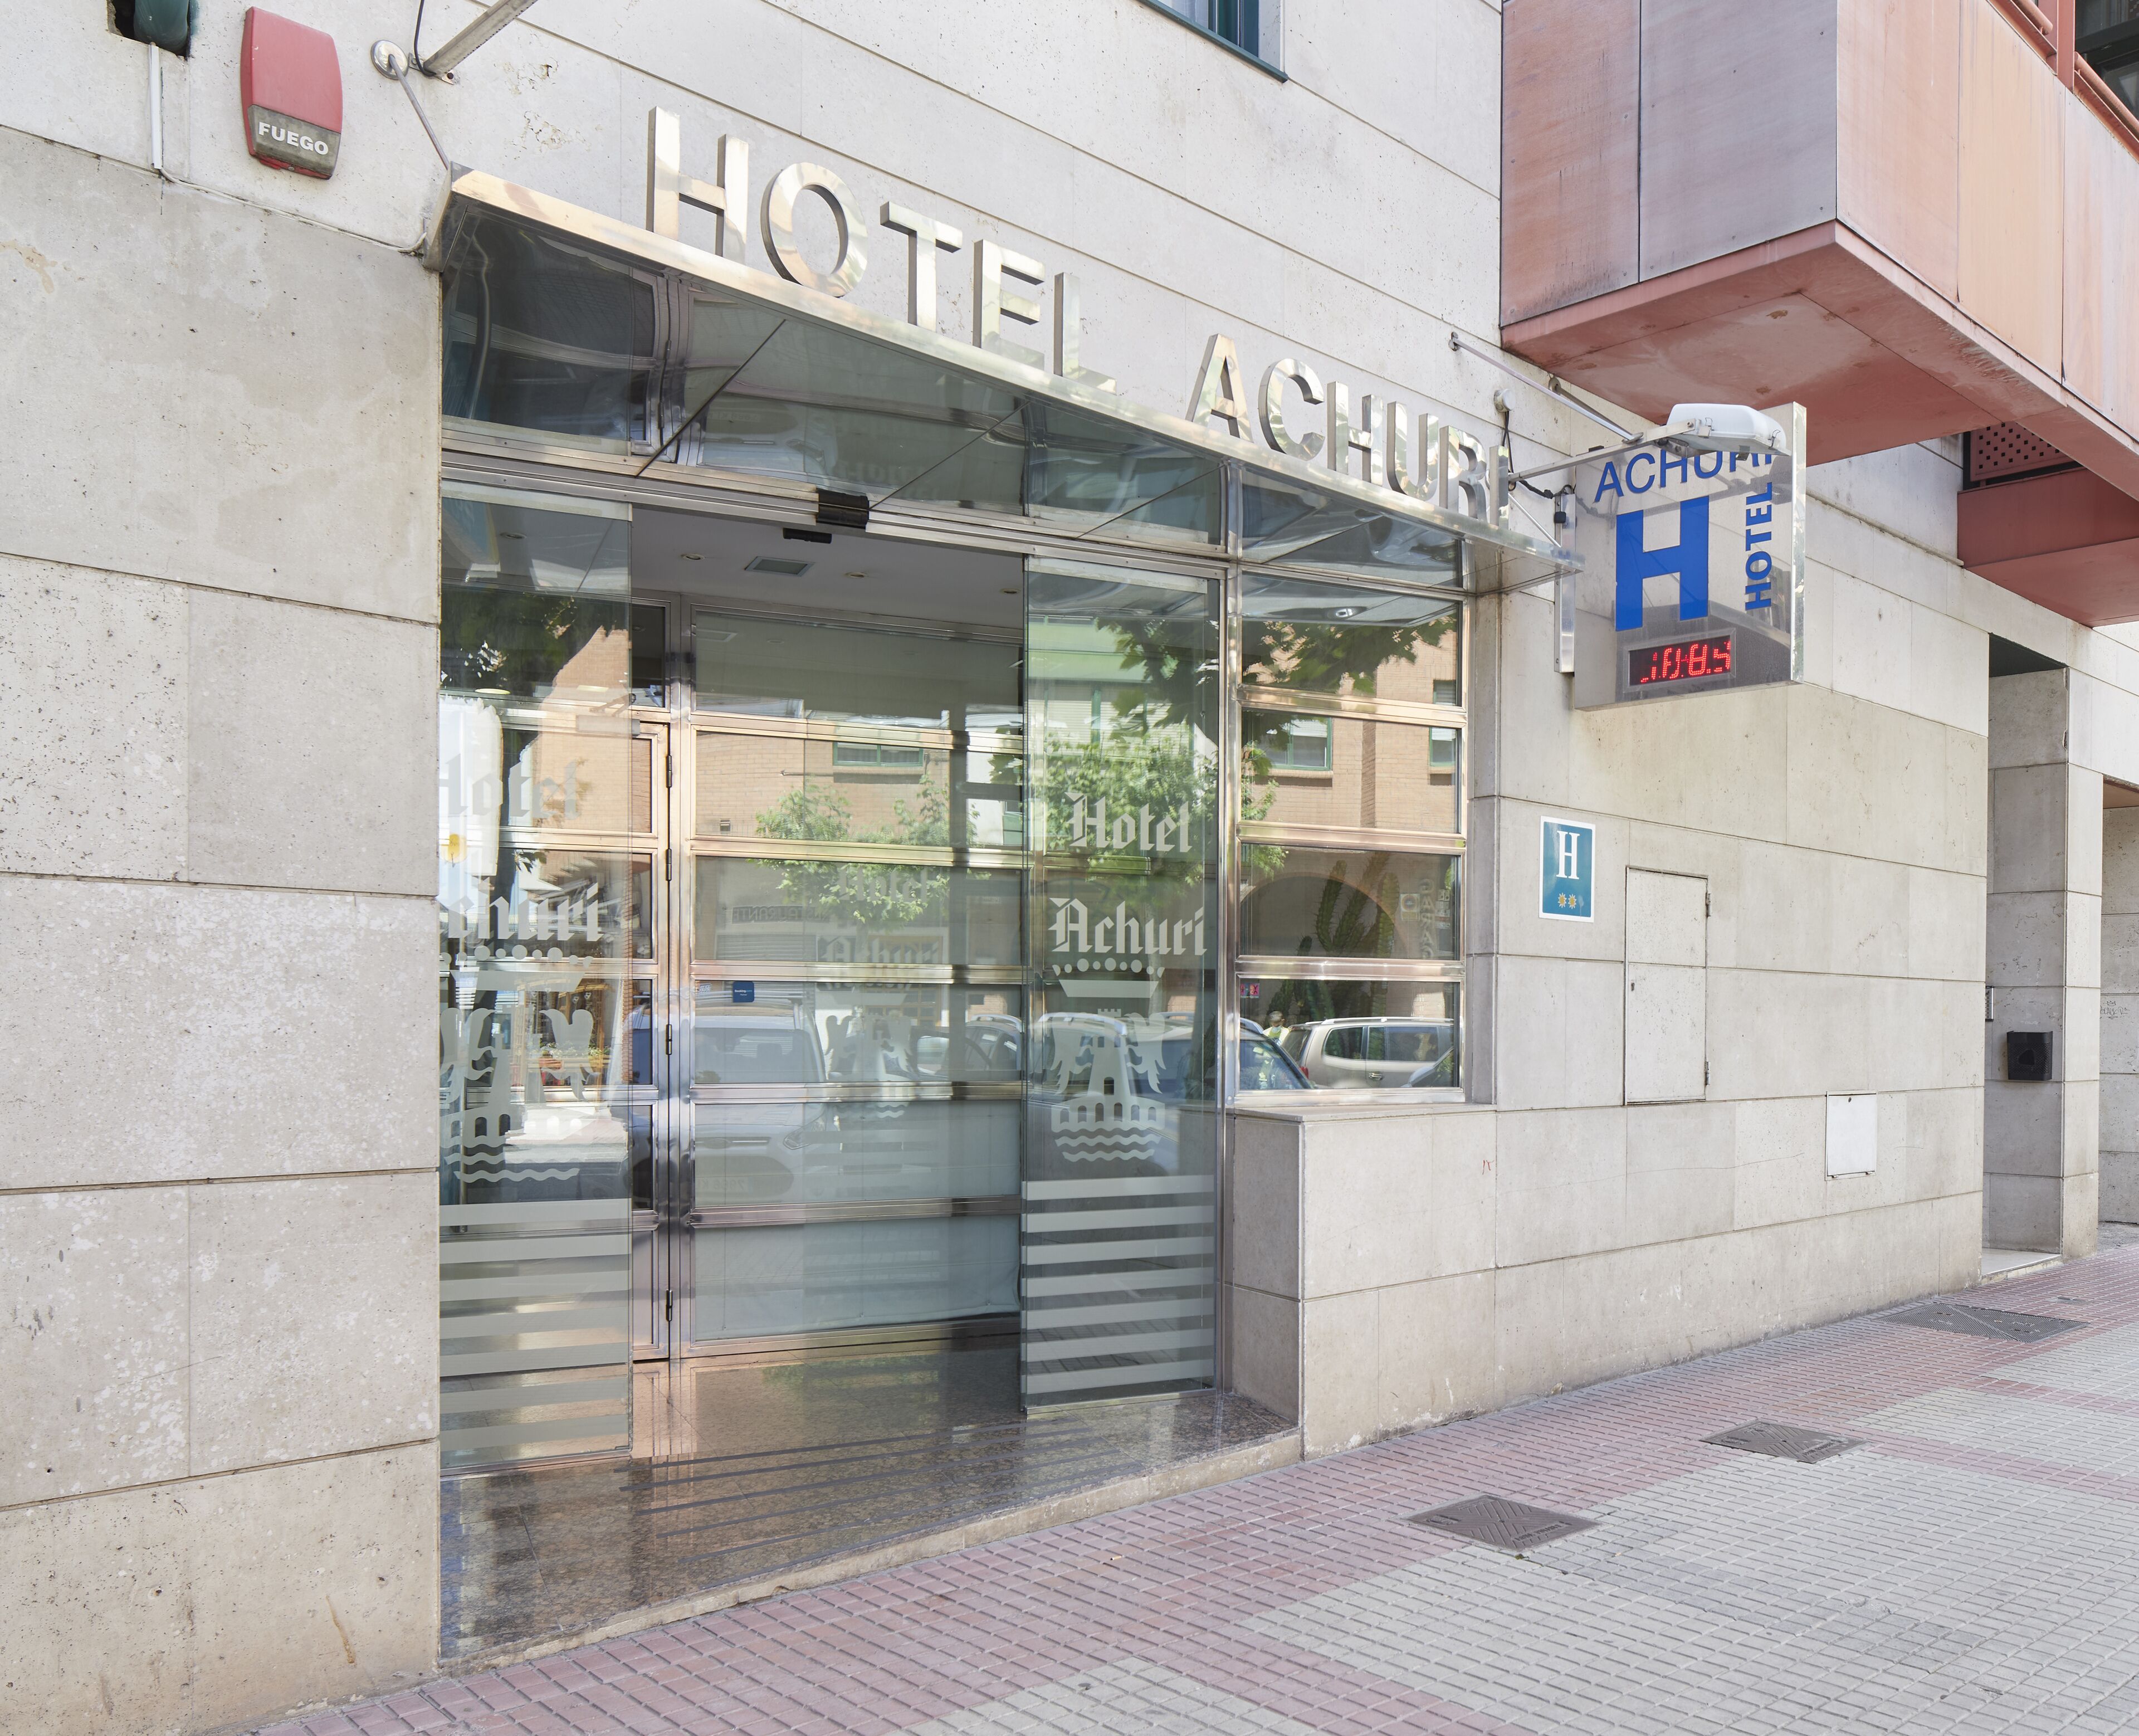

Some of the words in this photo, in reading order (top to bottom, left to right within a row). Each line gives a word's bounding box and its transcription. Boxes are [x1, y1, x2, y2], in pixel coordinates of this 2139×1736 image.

[258, 121, 329, 156] FUEGO
[647, 106, 1117, 395] HOTEL
[1185, 334, 1509, 529] ACHURI
[1615, 495, 1709, 631] H
[1745, 482, 1772, 611] HOTEL
[1064, 792, 1193, 853] Hotel
[1556, 830, 1580, 880] H
[439, 877, 604, 942] churi
[1048, 896, 1208, 955] Achuri
